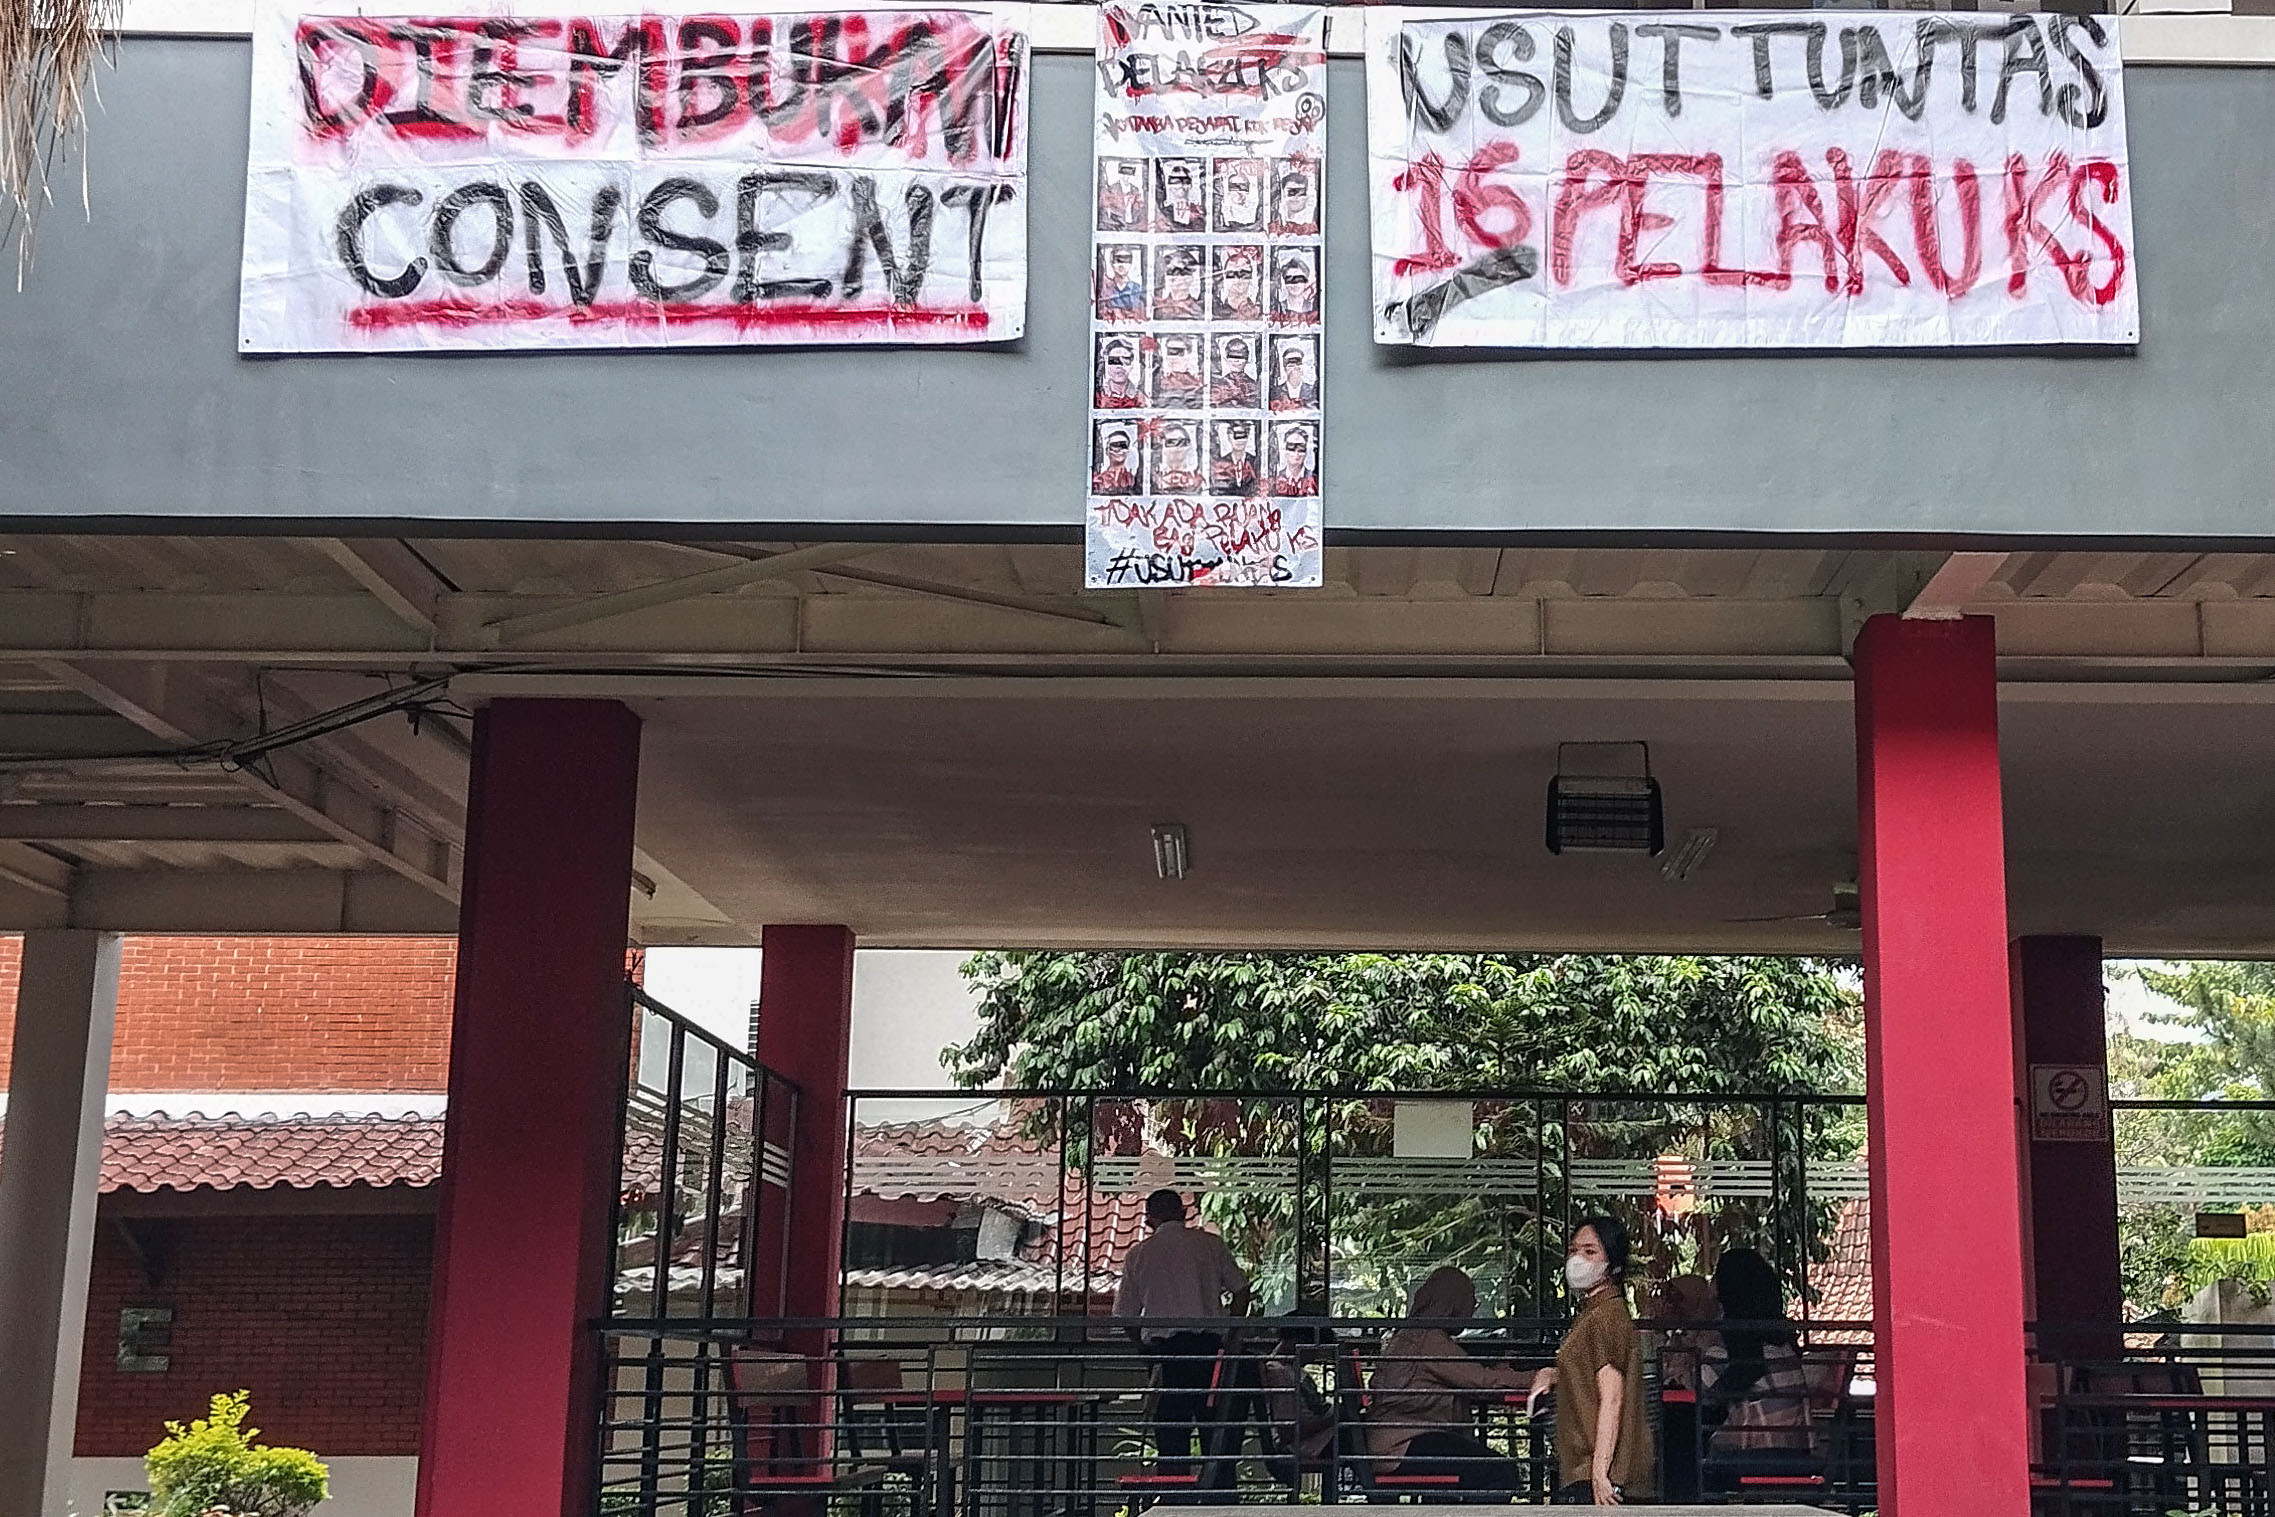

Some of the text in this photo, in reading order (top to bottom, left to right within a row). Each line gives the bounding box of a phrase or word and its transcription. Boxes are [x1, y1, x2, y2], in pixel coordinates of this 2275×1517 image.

[1400, 14, 2108, 133] USUT TUNTAS
[337, 172, 1015, 307] CONSENT
[1393, 141, 2126, 306] 16 PELAKU KS
[1160, 499, 1210, 528] ADA
[1287, 525, 1318, 554] KS
[117, 1308, 172, 1372] E
